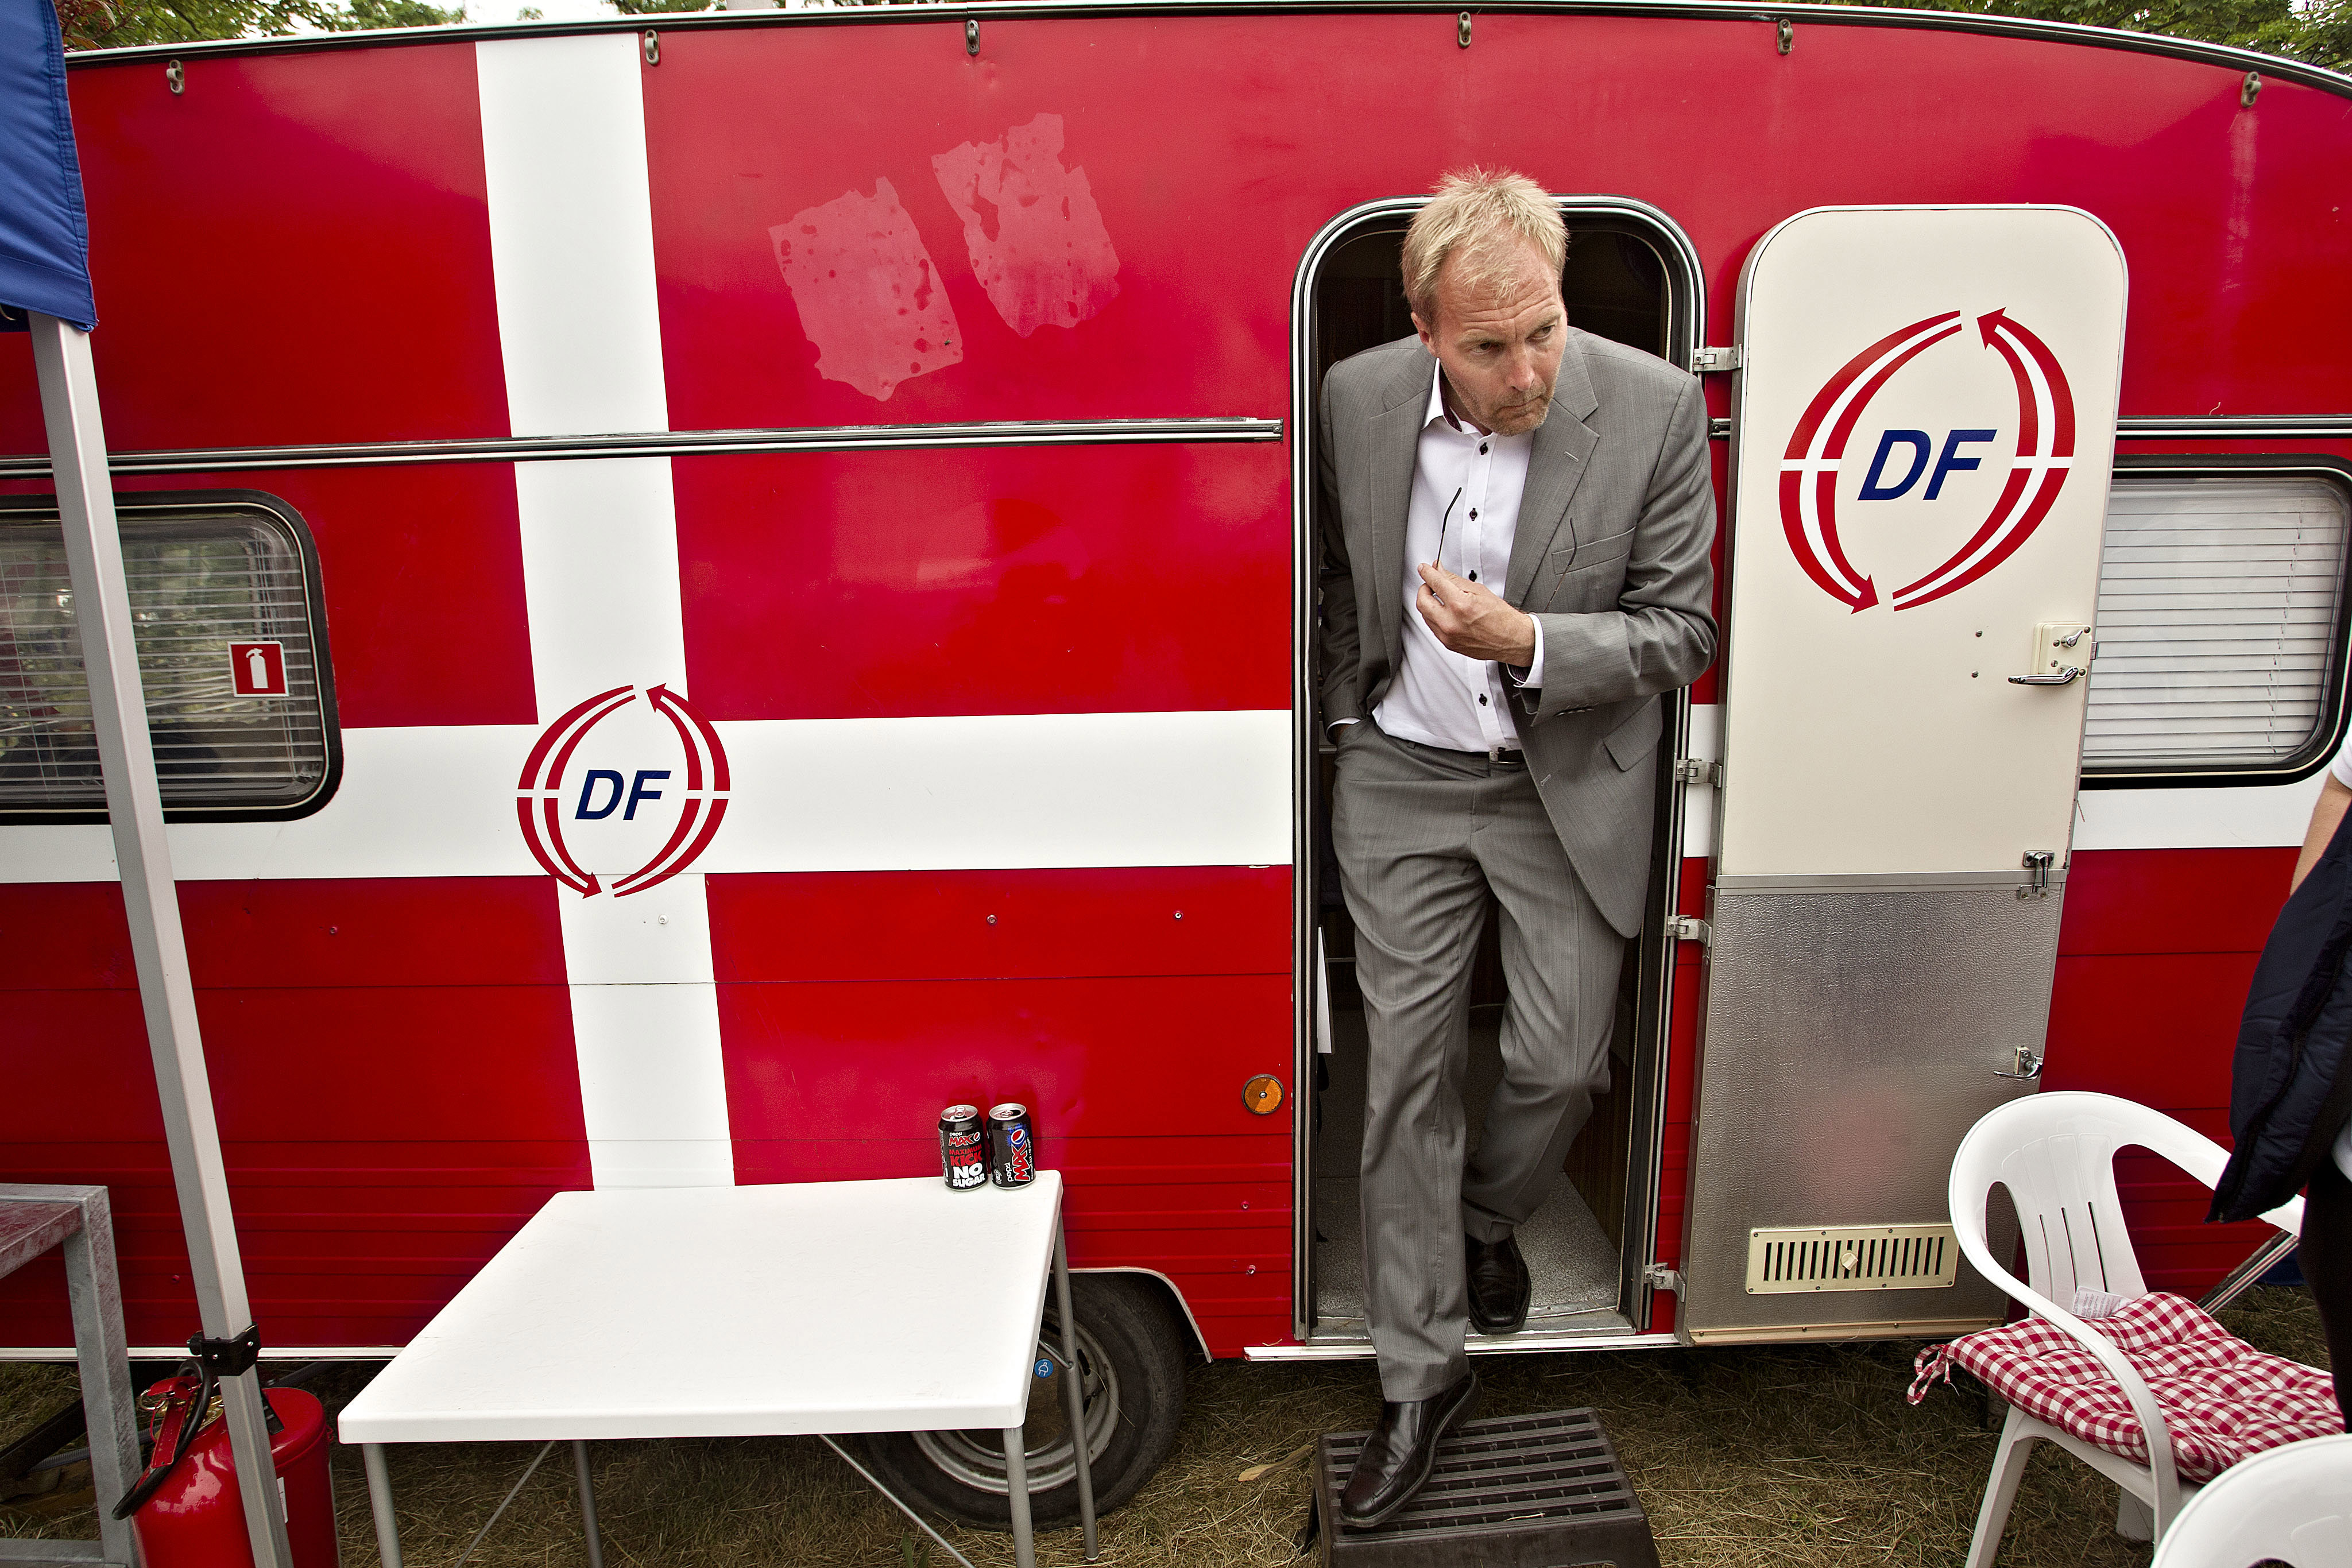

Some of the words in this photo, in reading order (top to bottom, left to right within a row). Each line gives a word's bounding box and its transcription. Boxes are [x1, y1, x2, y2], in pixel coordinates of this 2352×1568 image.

[1857, 429, 1998, 501] DF
[574, 769, 671, 820] DF
[948, 1133, 976, 1147] MAX
[949, 1143, 982, 1155] MAXIMUM
[950, 1150, 982, 1166] KICK
[1011, 1140, 1030, 1181] MAX
[953, 1162, 983, 1179] NO
[1004, 1162, 1013, 1182] pepsi
[952, 1173, 985, 1188] SUGAR
